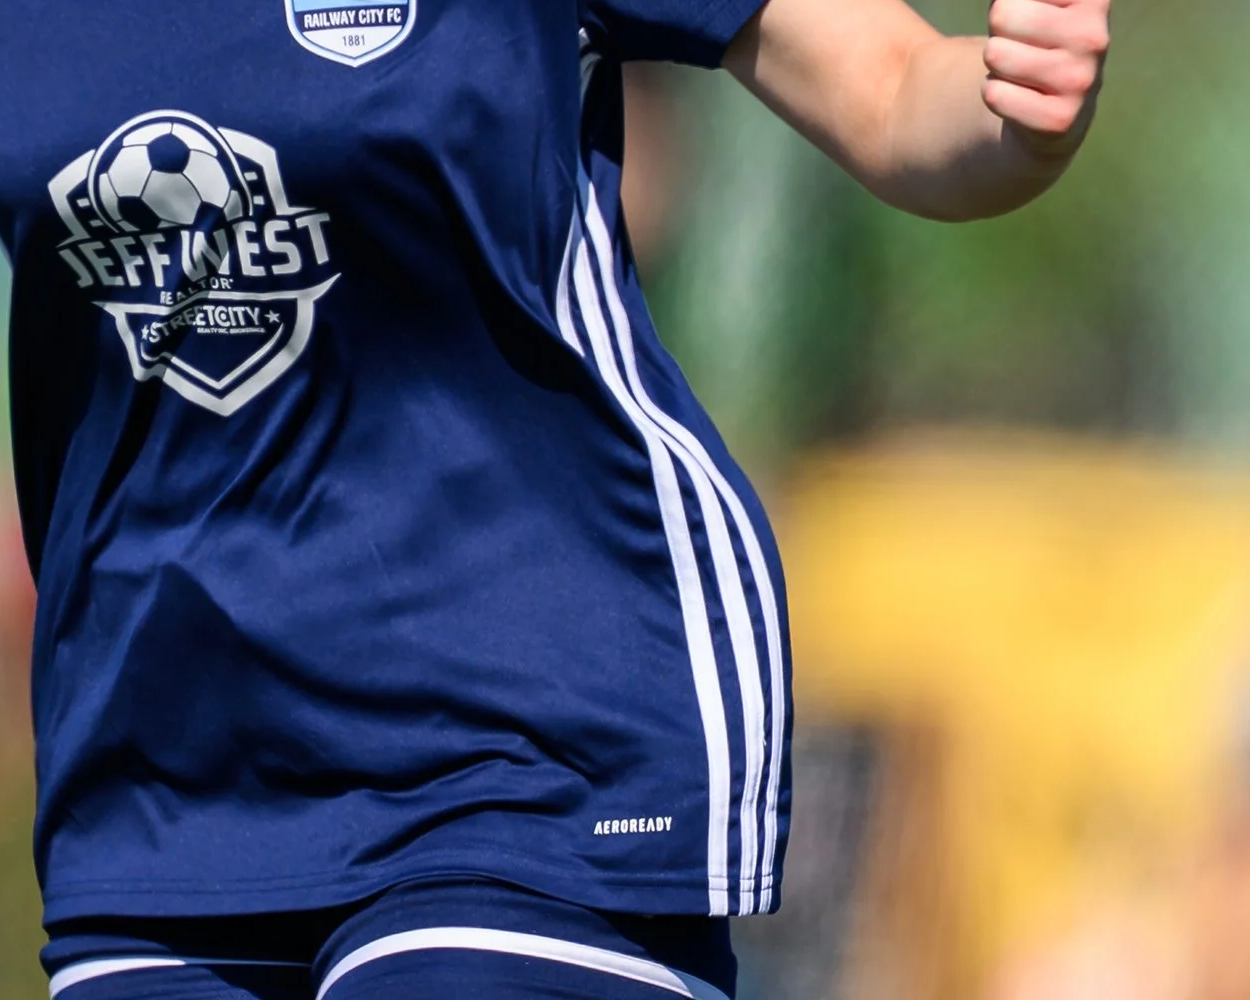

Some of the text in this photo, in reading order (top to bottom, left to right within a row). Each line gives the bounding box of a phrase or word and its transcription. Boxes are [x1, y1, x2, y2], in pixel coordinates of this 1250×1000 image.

[304, 7, 402, 29] RAILWAY CITY FC
[342, 34, 365, 47] 1881
[58, 212, 330, 288] JEFF WEST
[593, 816, 672, 835] AEROREADY
